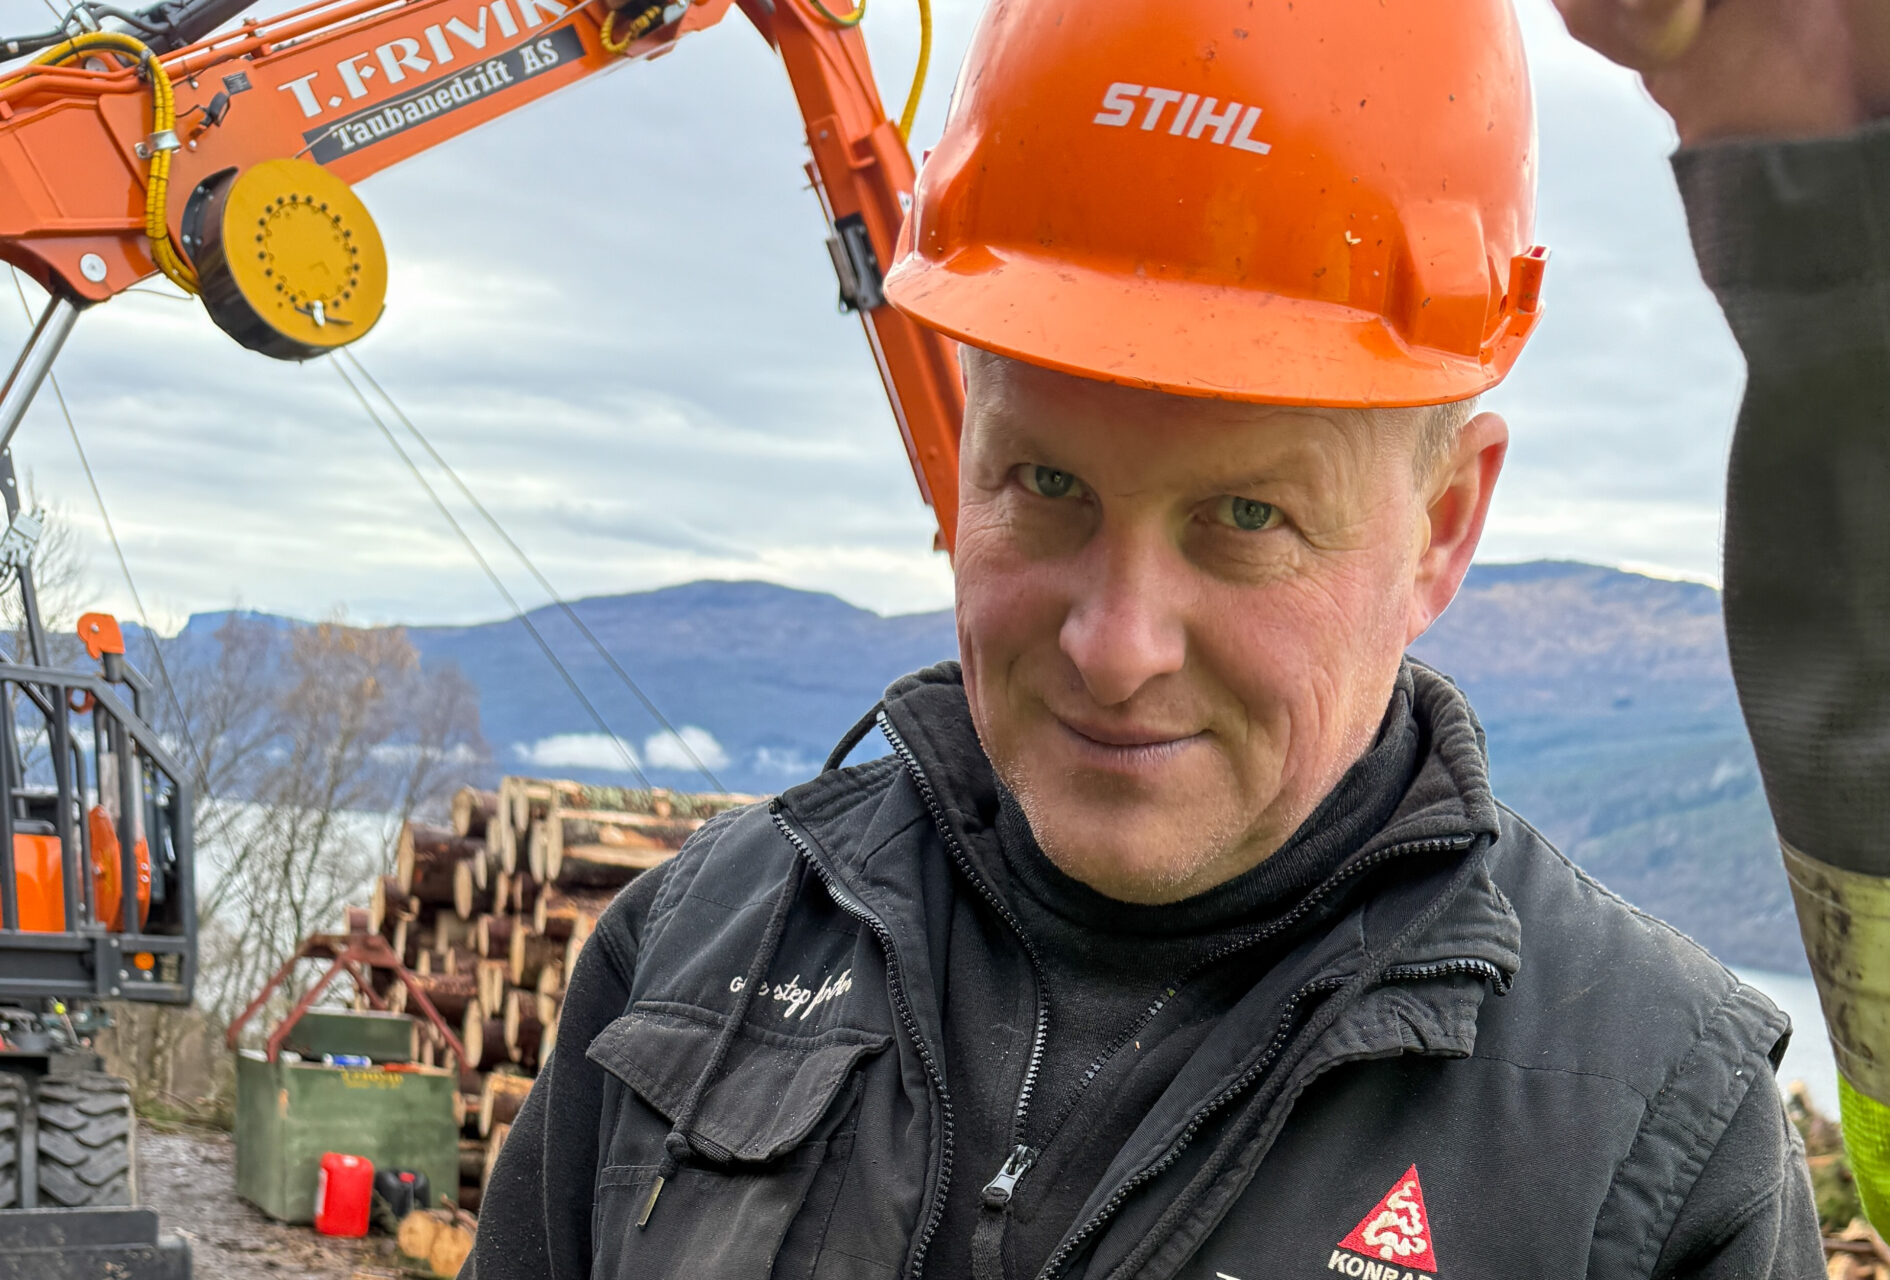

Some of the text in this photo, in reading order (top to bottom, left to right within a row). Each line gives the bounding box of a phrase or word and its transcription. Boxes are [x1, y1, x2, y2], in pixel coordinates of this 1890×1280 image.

[331, 38, 561, 152] Taubanedrift AS
[1092, 81, 1273, 156] STIHL
